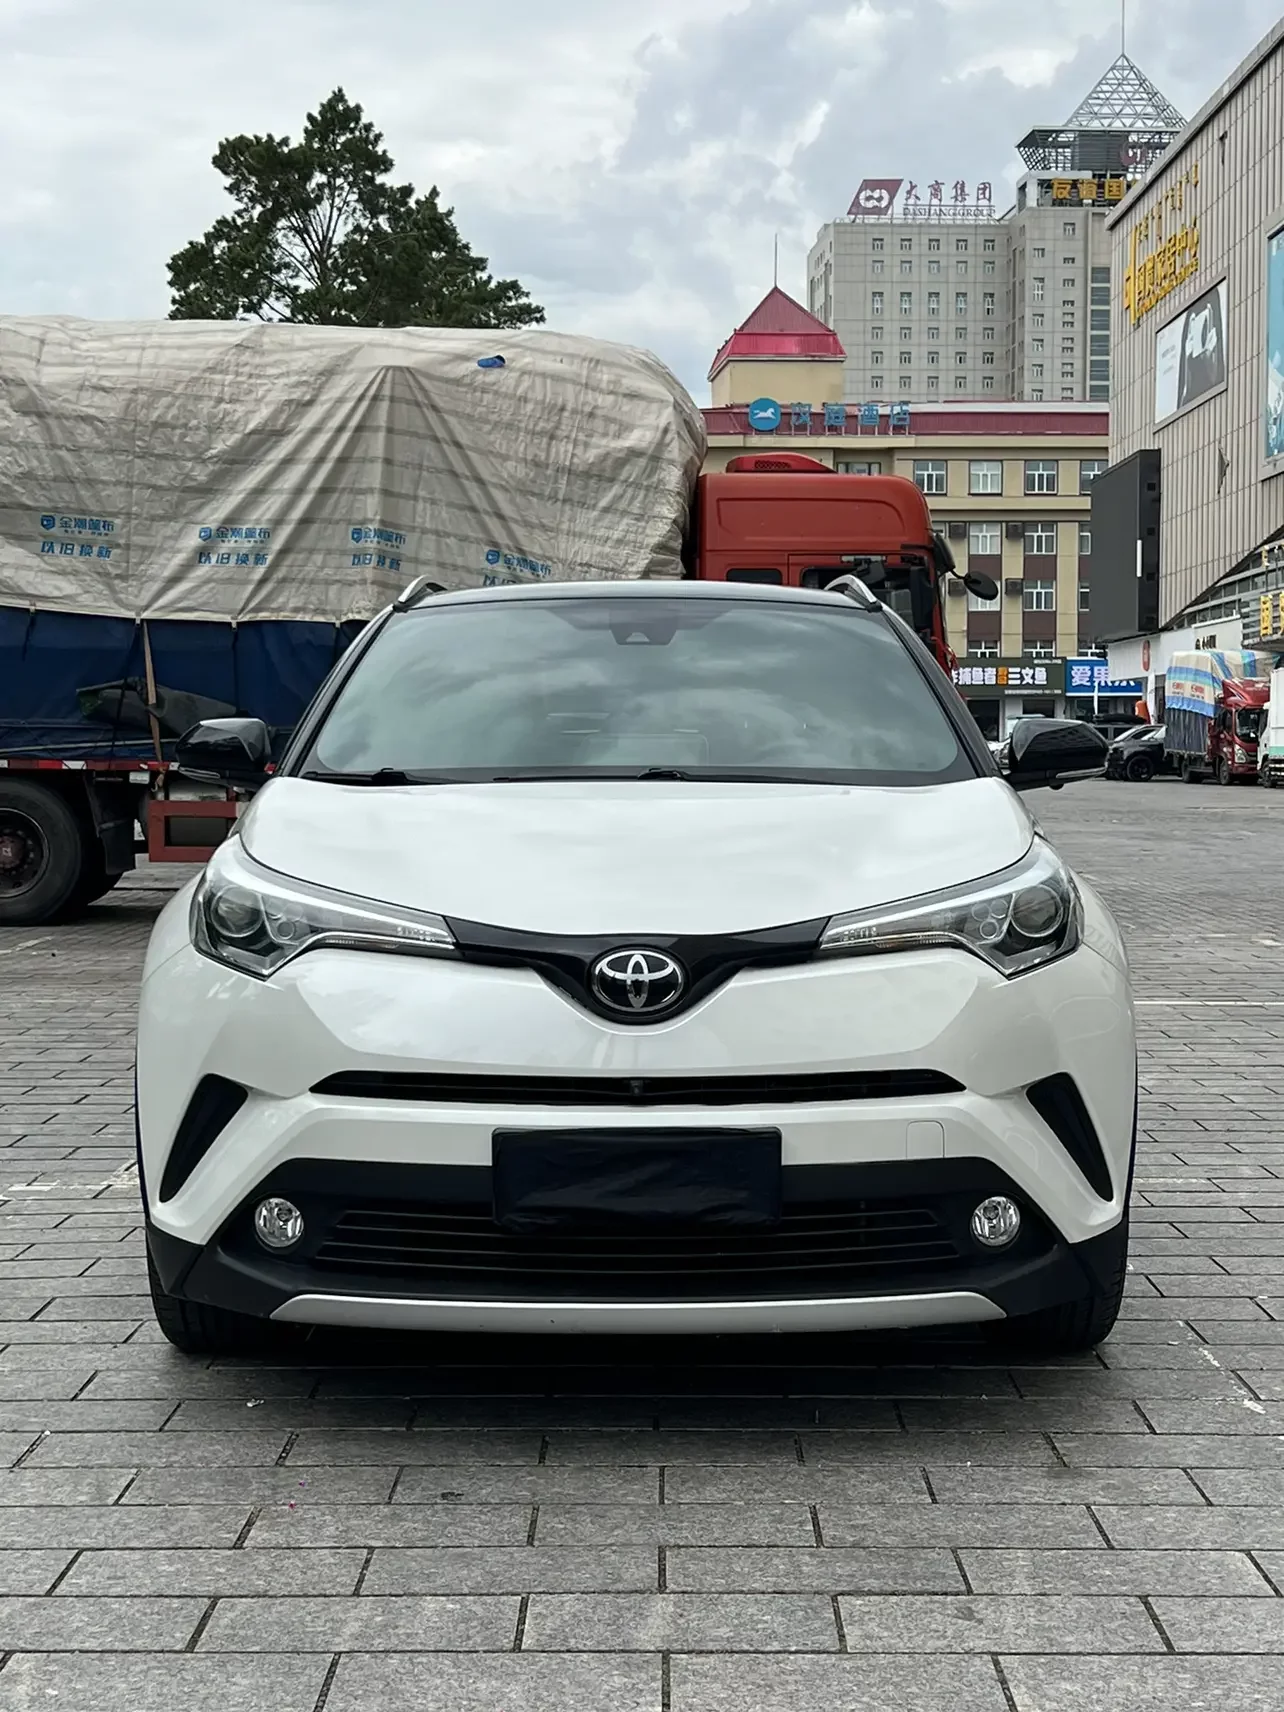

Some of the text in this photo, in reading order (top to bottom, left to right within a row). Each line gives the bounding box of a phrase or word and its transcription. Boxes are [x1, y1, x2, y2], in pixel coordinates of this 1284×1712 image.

[904, 180, 993, 202] 大商集团
[1051, 178, 1138, 200] 友谊国
[903, 207, 996, 217] DASHANG GROUP
[41, 541, 111, 559] 以旧换新
[199, 552, 268, 566] 以旧换新
[351, 553, 401, 571] 以旧换新
[1071, 665, 1136, 687] 爱果
